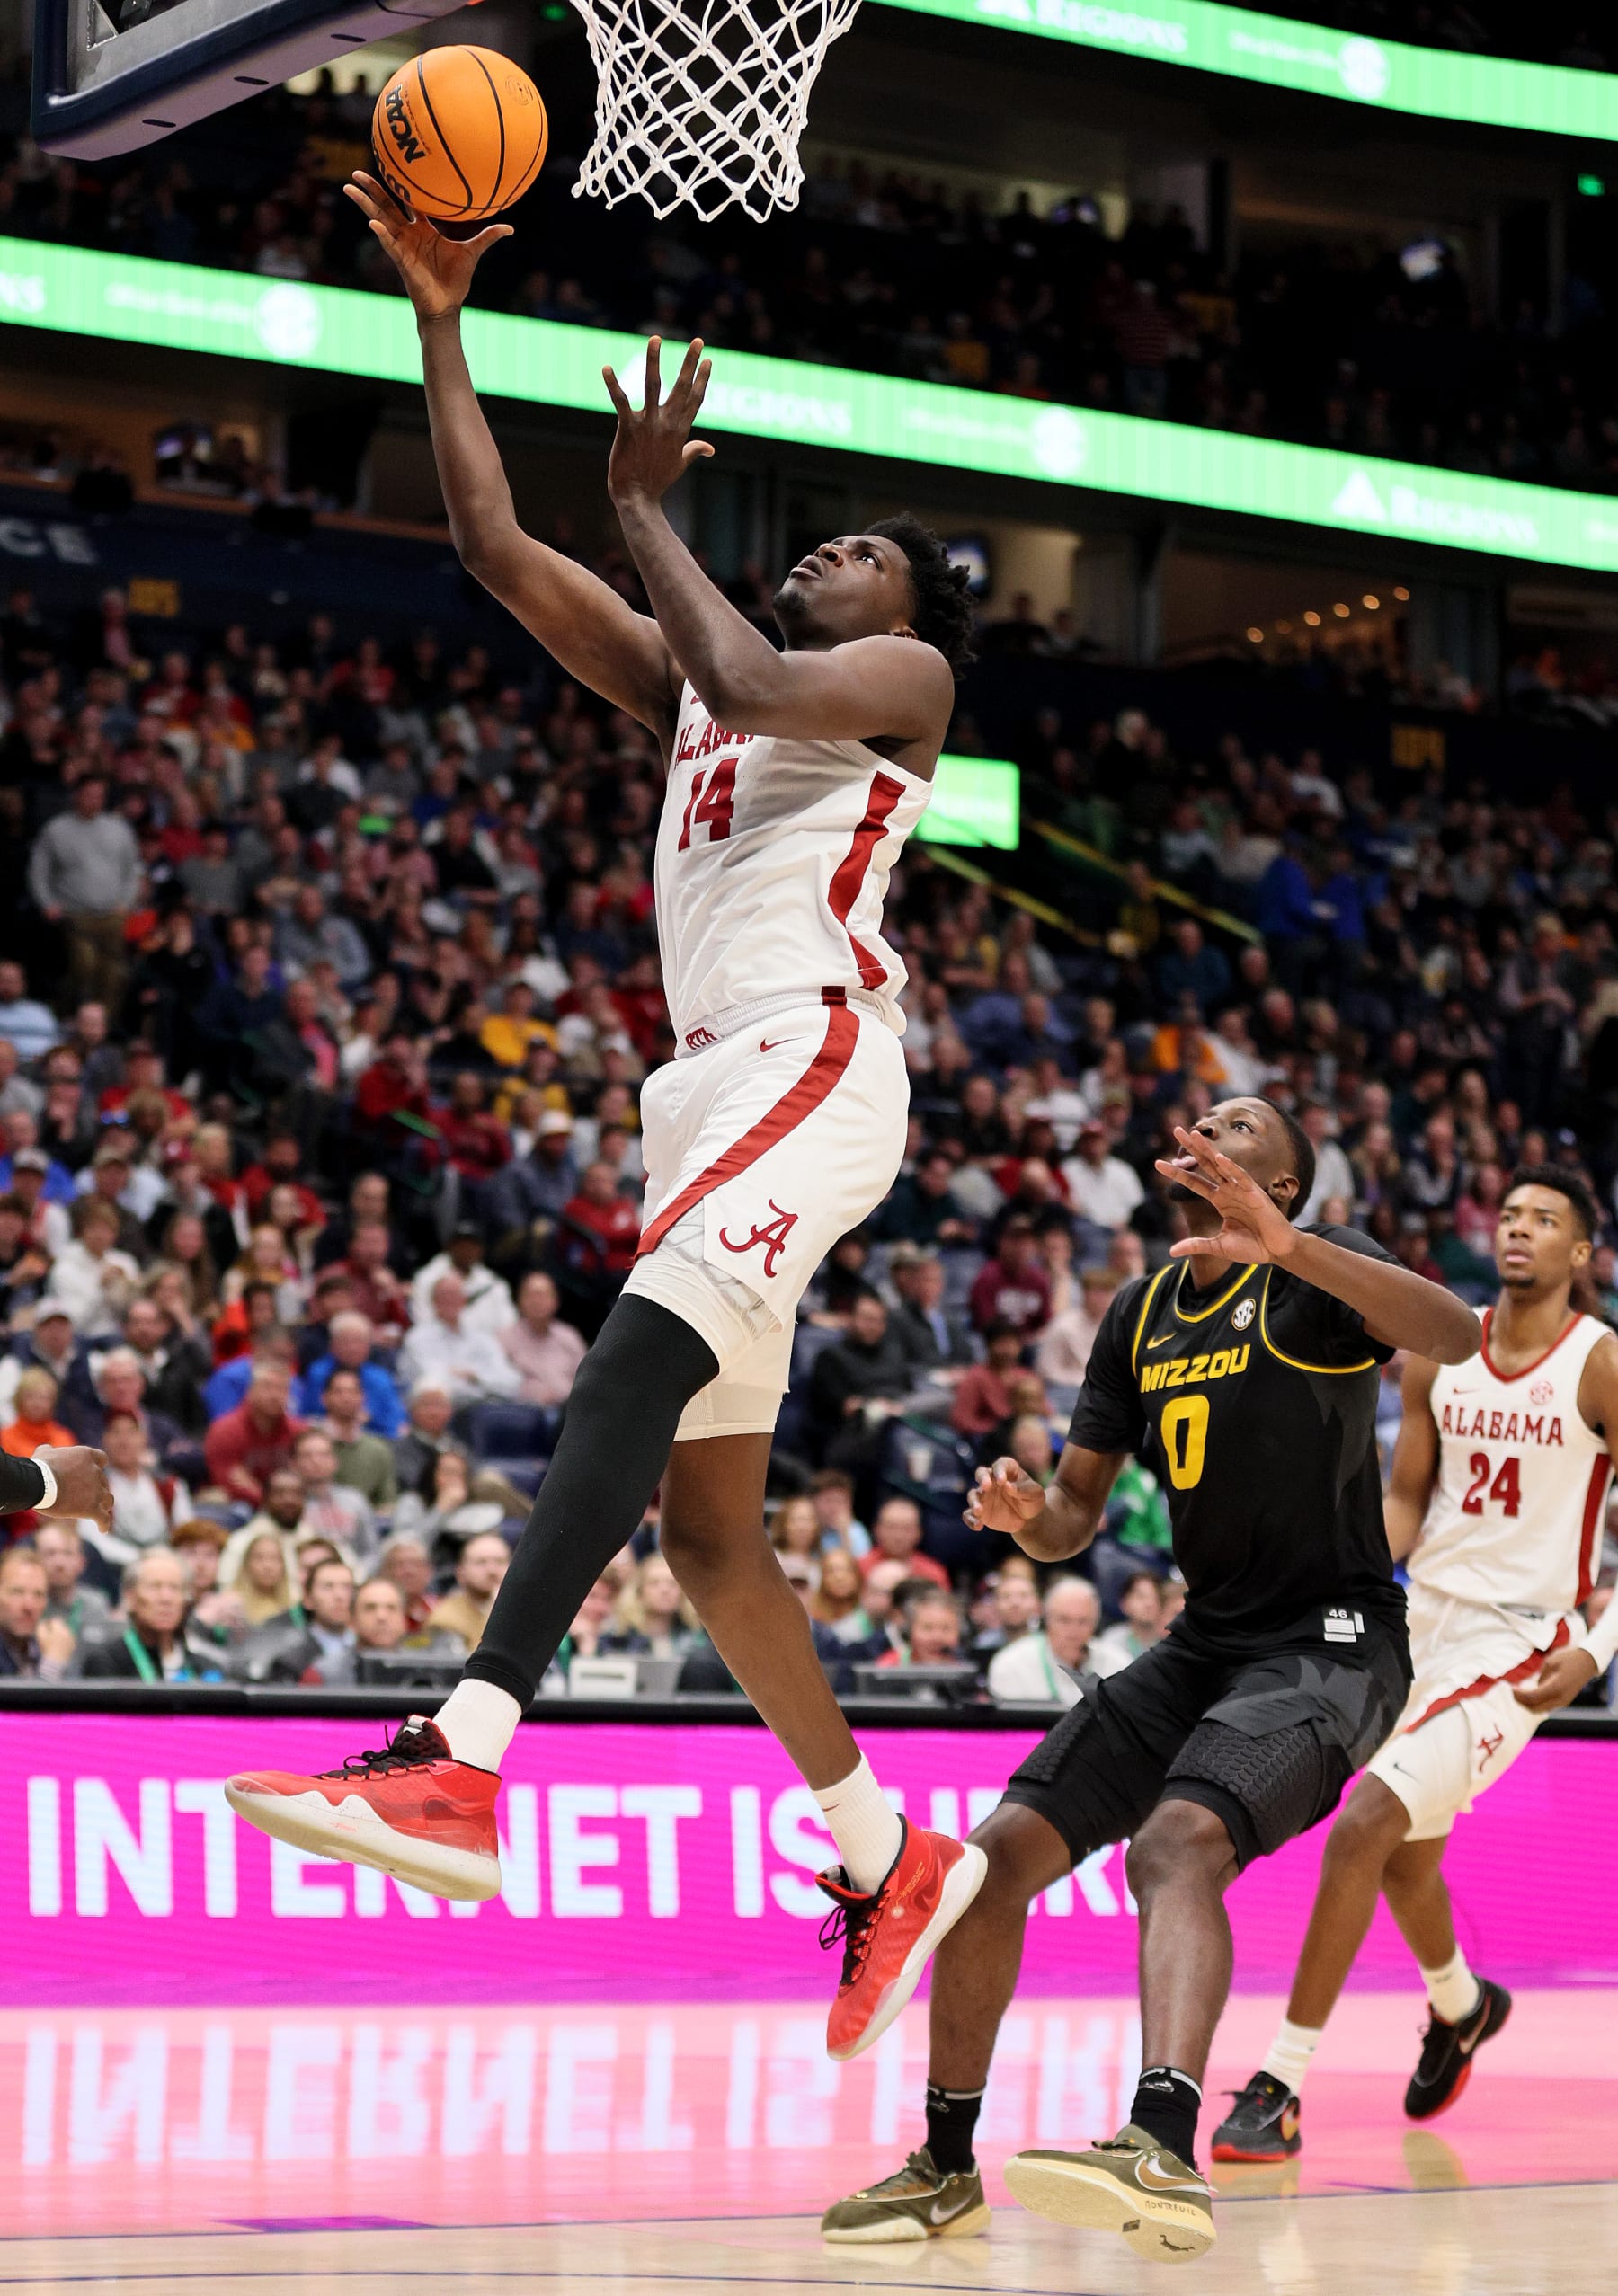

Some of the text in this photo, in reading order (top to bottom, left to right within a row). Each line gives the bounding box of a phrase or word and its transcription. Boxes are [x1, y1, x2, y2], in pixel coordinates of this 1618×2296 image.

[385, 83, 426, 164] NCAA
[678, 757, 740, 852] 14
[1140, 1343, 1250, 1393] MIZZOU
[1160, 1394, 1210, 1491] 0
[1443, 1404, 1565, 1447] ALABAMA
[1462, 1452, 1521, 1518] 24
[1329, 1609, 1348, 1619] 46
[26, 1776, 702, 1919] INTENET
